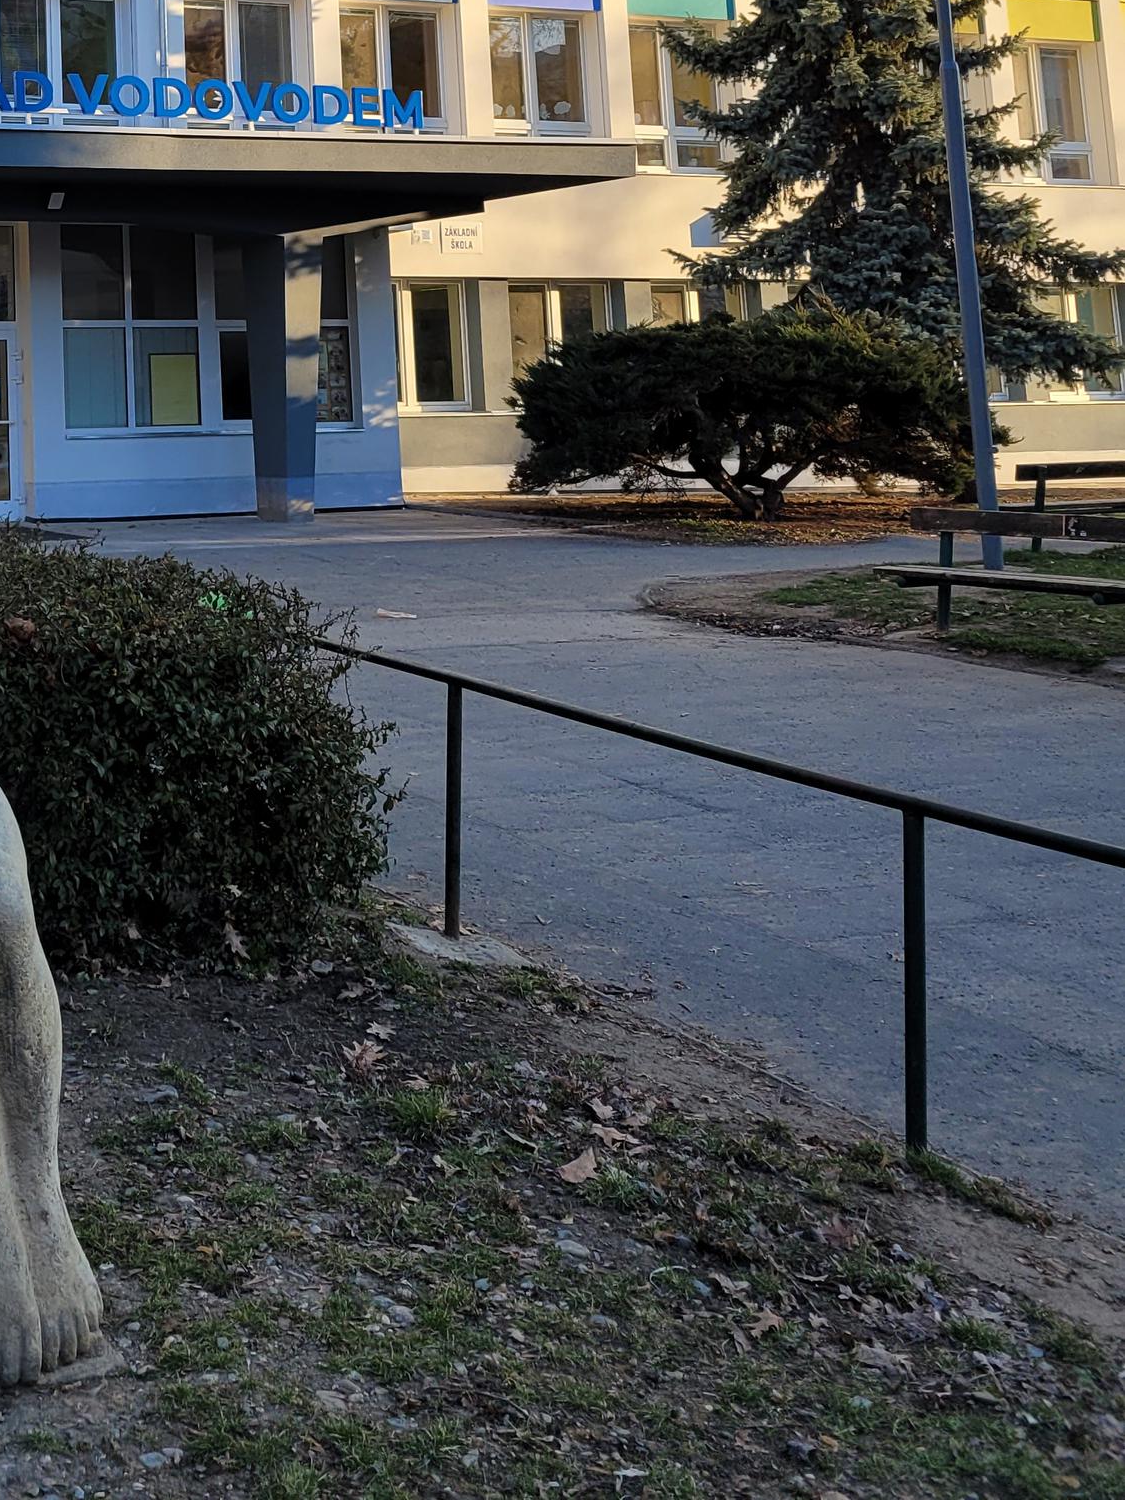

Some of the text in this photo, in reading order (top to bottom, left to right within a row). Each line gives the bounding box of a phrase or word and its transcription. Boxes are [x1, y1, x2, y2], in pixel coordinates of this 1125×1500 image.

[67, 72, 424, 130] VODOVODEM
[444, 225, 478, 237] ZÁKLADNÍ
[450, 238, 474, 250] ŠKOLA
